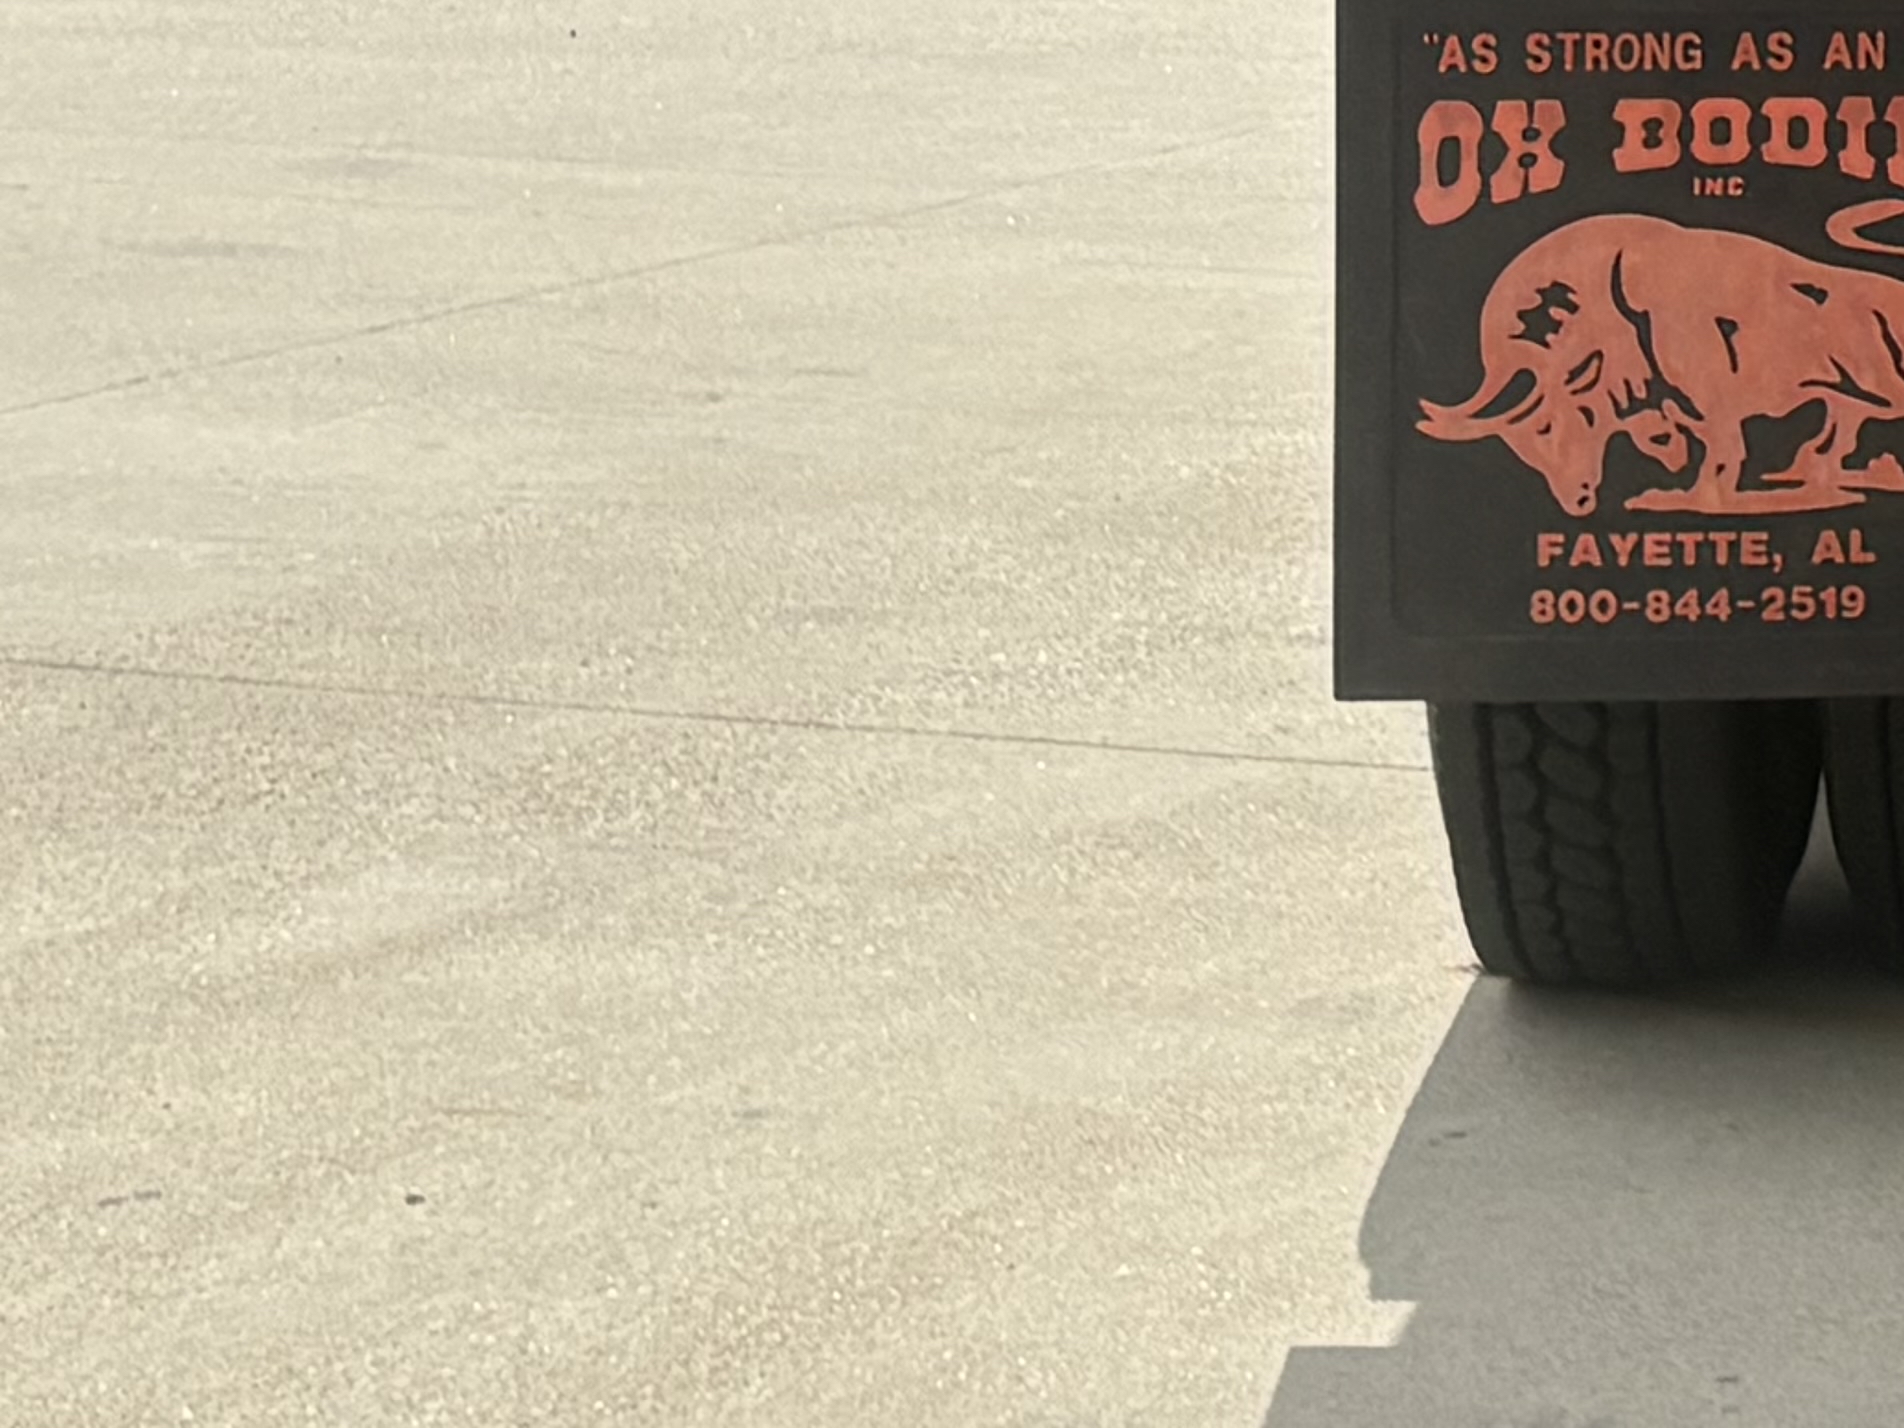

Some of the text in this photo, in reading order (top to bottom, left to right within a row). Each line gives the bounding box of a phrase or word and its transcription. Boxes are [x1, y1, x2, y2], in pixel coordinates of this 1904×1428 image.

[1525, 31, 1704, 76] STRONG
[1731, 31, 1797, 73] AS
[1823, 30, 1887, 73] AN
[1413, 99, 1569, 227] OX
[1693, 176, 1746, 199] INC
[1535, 528, 1878, 573] FAYETTE, AL
[1529, 584, 1868, 626] 800-844-2519
